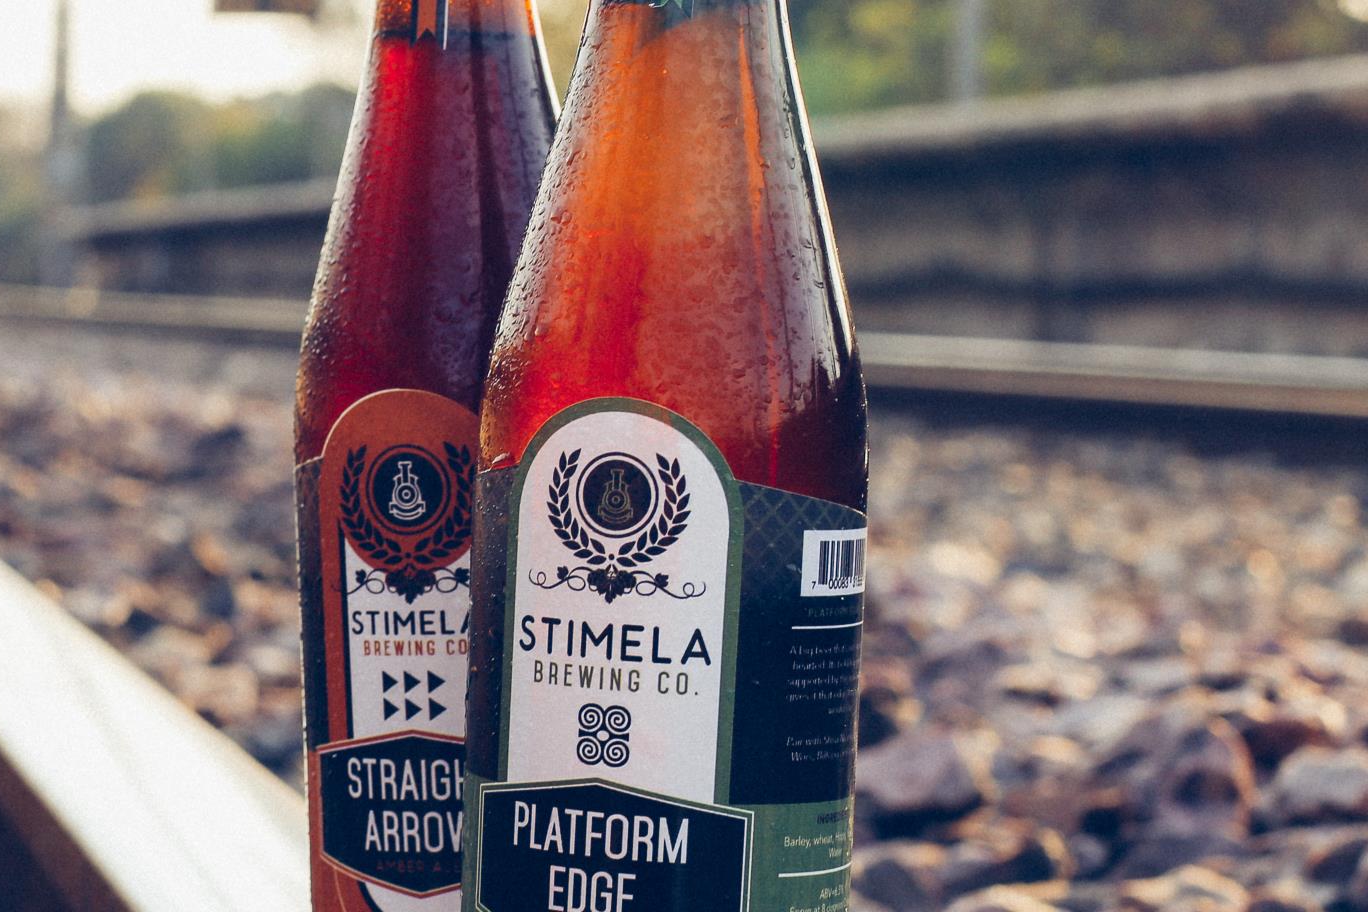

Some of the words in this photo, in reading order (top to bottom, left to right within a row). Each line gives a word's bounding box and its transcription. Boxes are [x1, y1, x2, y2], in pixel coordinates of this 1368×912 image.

[363, 640, 435, 656] BREWING
[519, 614, 712, 667] STIMELA
[533, 660, 641, 693] BREWING
[657, 671, 699, 696] CO.
[347, 757, 465, 801] STRAIGH
[513, 800, 689, 864] PLATFORM
[783, 836, 812, 849] Barley,
[548, 864, 636, 912] EDGE
